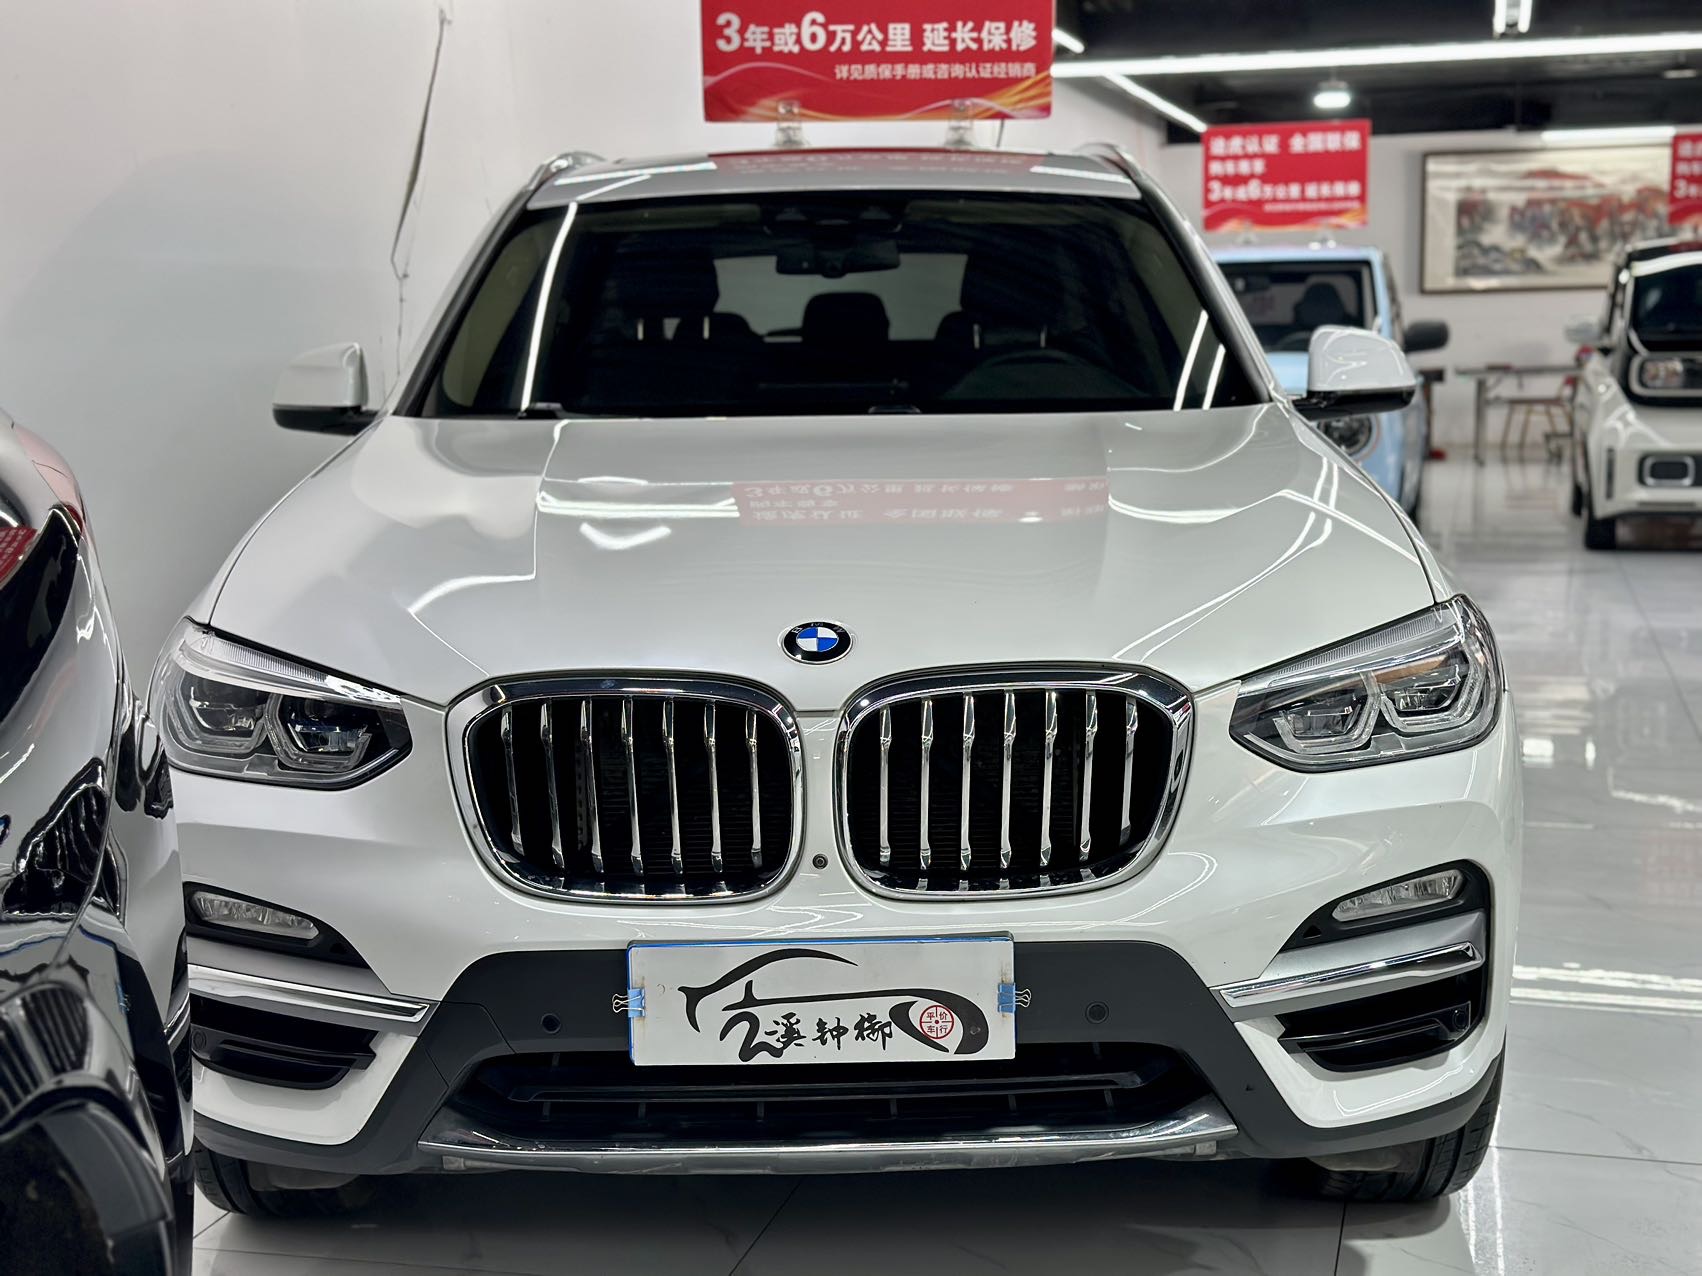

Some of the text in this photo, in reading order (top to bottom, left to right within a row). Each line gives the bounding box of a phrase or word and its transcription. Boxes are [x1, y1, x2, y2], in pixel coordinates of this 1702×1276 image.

[715, 11, 1037, 54] 3年或6万公里 延长保修
[834, 62, 1037, 80] 详见质保手册或咨询认证经销商
[926, 1011, 948, 1021] 平价
[926, 1025, 948, 1034] 车行
